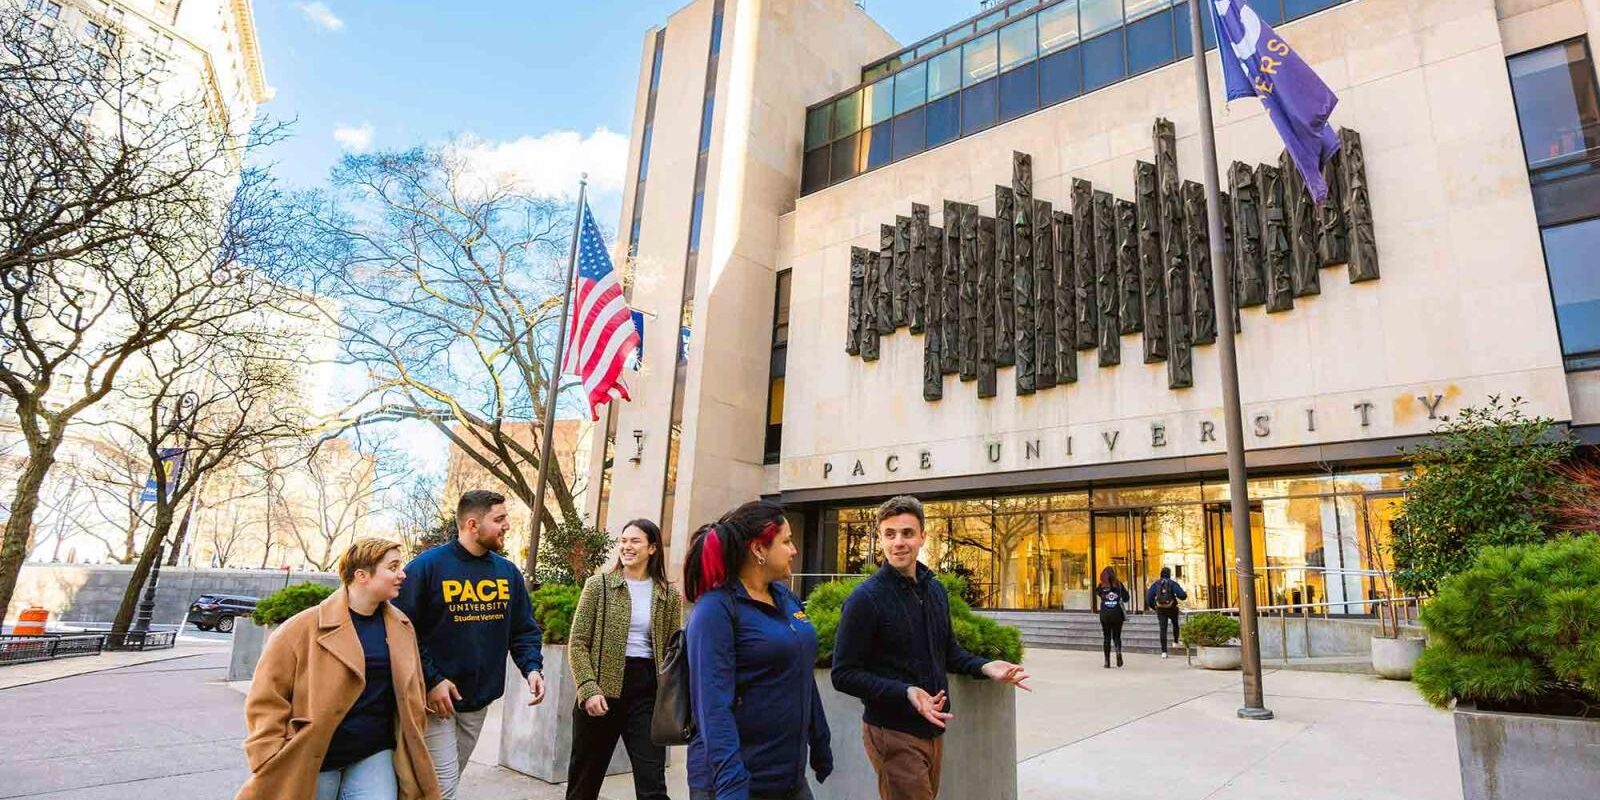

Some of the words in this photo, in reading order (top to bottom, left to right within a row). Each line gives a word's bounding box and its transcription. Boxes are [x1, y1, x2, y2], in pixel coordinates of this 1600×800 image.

[823, 451, 932, 479] PACE
[987, 394, 1443, 465] UNIVERSITY
[442, 579, 510, 603] PACE
[449, 601, 509, 612] UNIVERSITY
[453, 614, 480, 622] Student
